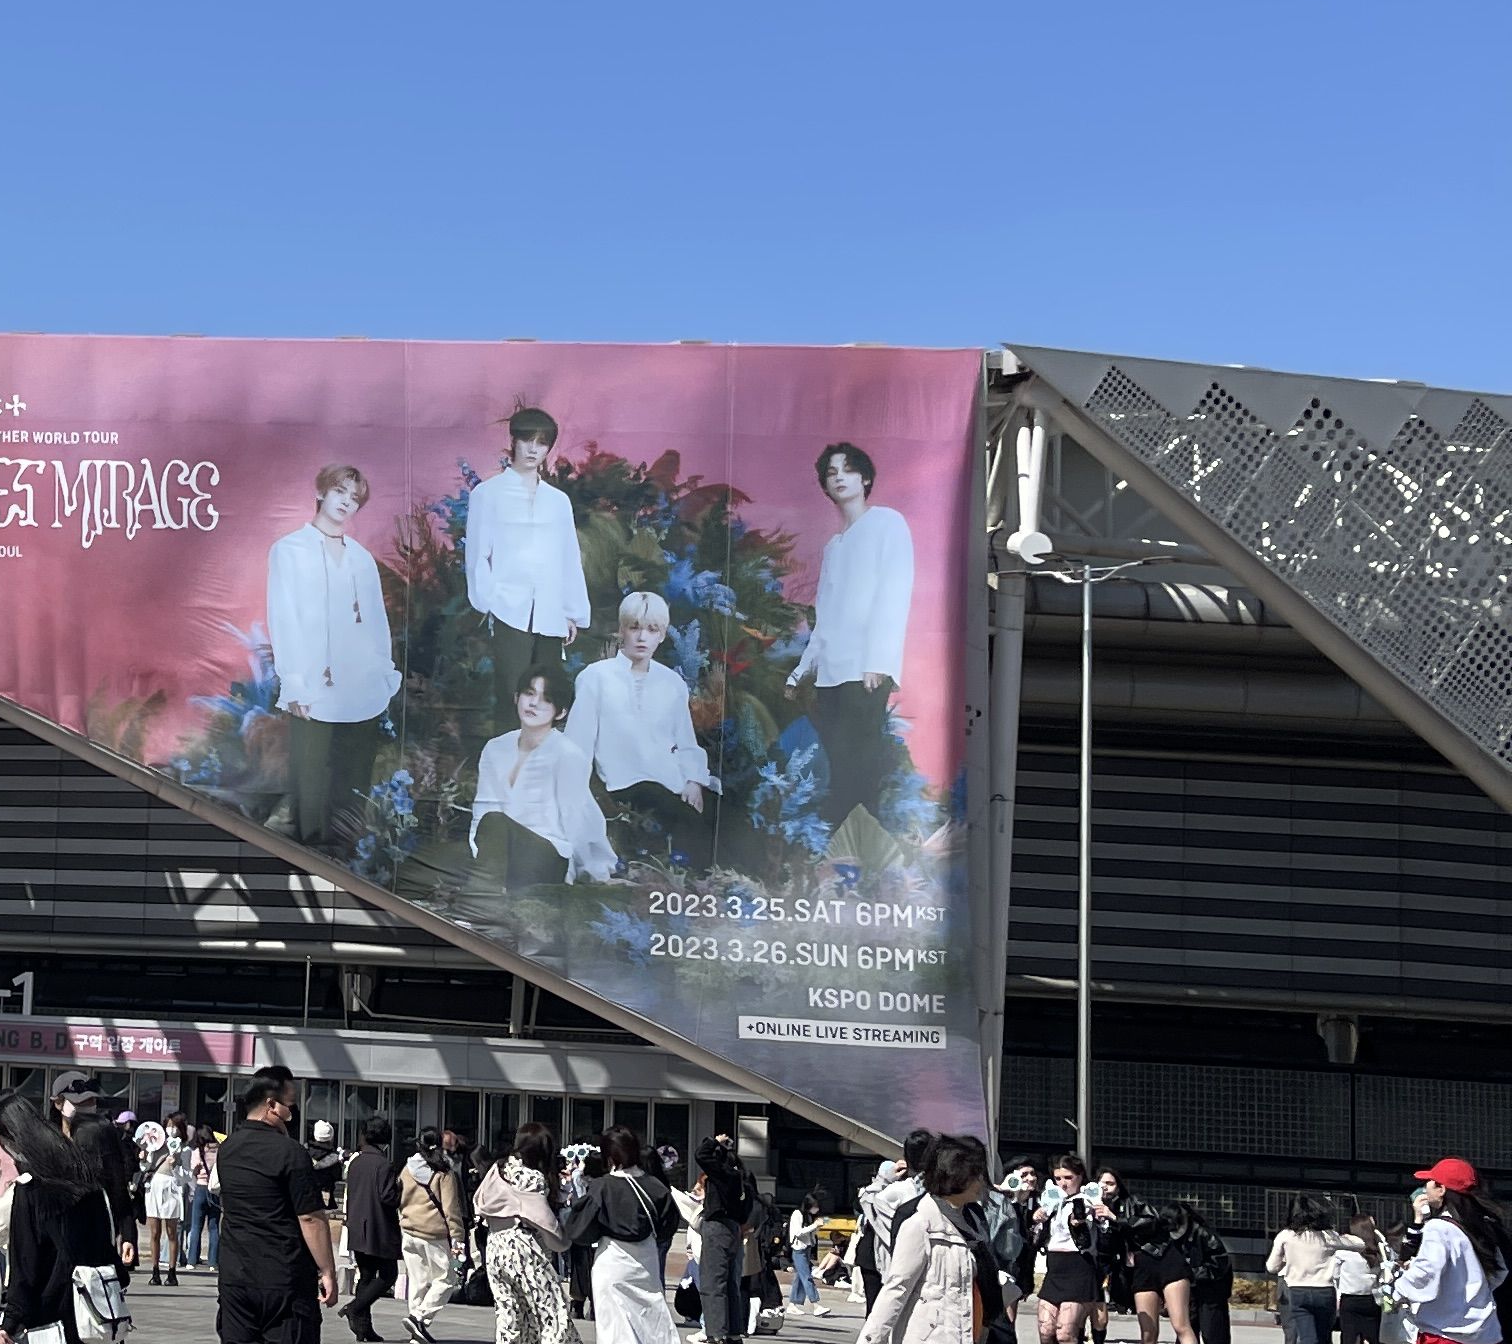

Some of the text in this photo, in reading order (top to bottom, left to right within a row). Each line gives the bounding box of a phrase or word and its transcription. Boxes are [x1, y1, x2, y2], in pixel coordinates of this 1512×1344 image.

[32, 431, 81, 444] WORLD
[84, 431, 119, 445] TOUR
[51, 457, 220, 549] MIRAGE
[648, 890, 947, 928] 2023.3.25.SAT 6PM KST
[649, 932, 948, 972] 2023.3.26.SUN 6PM KST
[808, 986, 946, 1014] KSPO DOME
[55, 1031, 69, 1050] D
[74, 1033, 103, 1052] 구역
[107, 1035, 136, 1054] 입장
[815, 1025, 849, 1040] LIVE
[852, 1027, 941, 1044] STREAMING
